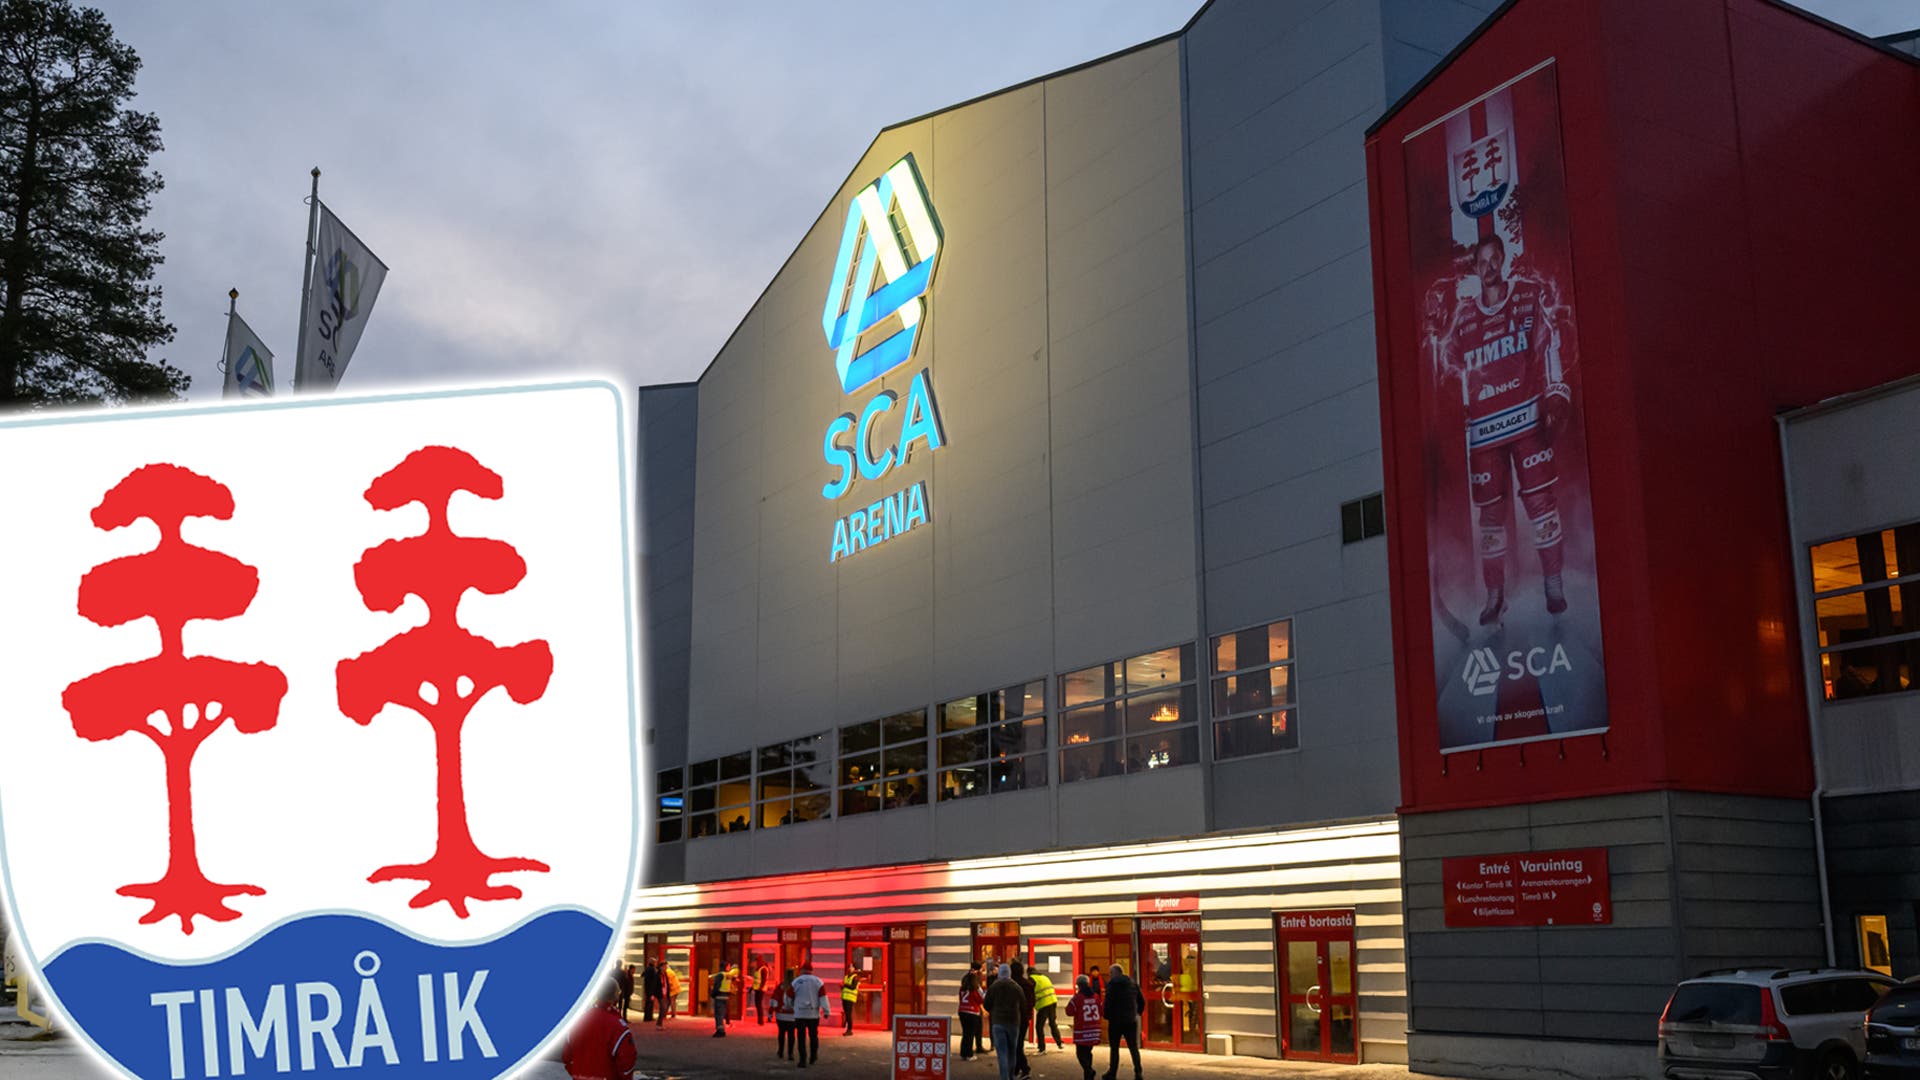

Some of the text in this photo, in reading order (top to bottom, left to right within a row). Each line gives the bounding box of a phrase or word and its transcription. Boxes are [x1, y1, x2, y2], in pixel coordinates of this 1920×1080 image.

[1463, 324, 1529, 371] TIMRÅ
[1496, 378, 1520, 394] NHC
[1479, 412, 1528, 436] BILBOLAGET
[822, 372, 941, 499] SCA
[830, 483, 927, 563] ARENA
[1507, 643, 1572, 680] SCA
[1504, 713, 1513, 721] av
[1514, 707, 1545, 719] skogens
[1479, 861, 1511, 876] Entré
[1519, 858, 1583, 873] Varuintag
[1462, 880, 1513, 890] Kontor Timrå IK
[1521, 877, 1588, 887] Arenarestaurangen
[1154, 897, 1180, 909] Kontor
[1462, 894, 1515, 904] Lunchrestaurang
[1522, 891, 1551, 901] Timrå IK
[1478, 907, 1515, 917] Biljettkassa
[1080, 919, 1108, 935] Entré
[1140, 916, 1201, 933] Biljettförsäljning
[1280, 913, 1352, 928] Entré bortastå
[1082, 1004, 1100, 1022] 23
